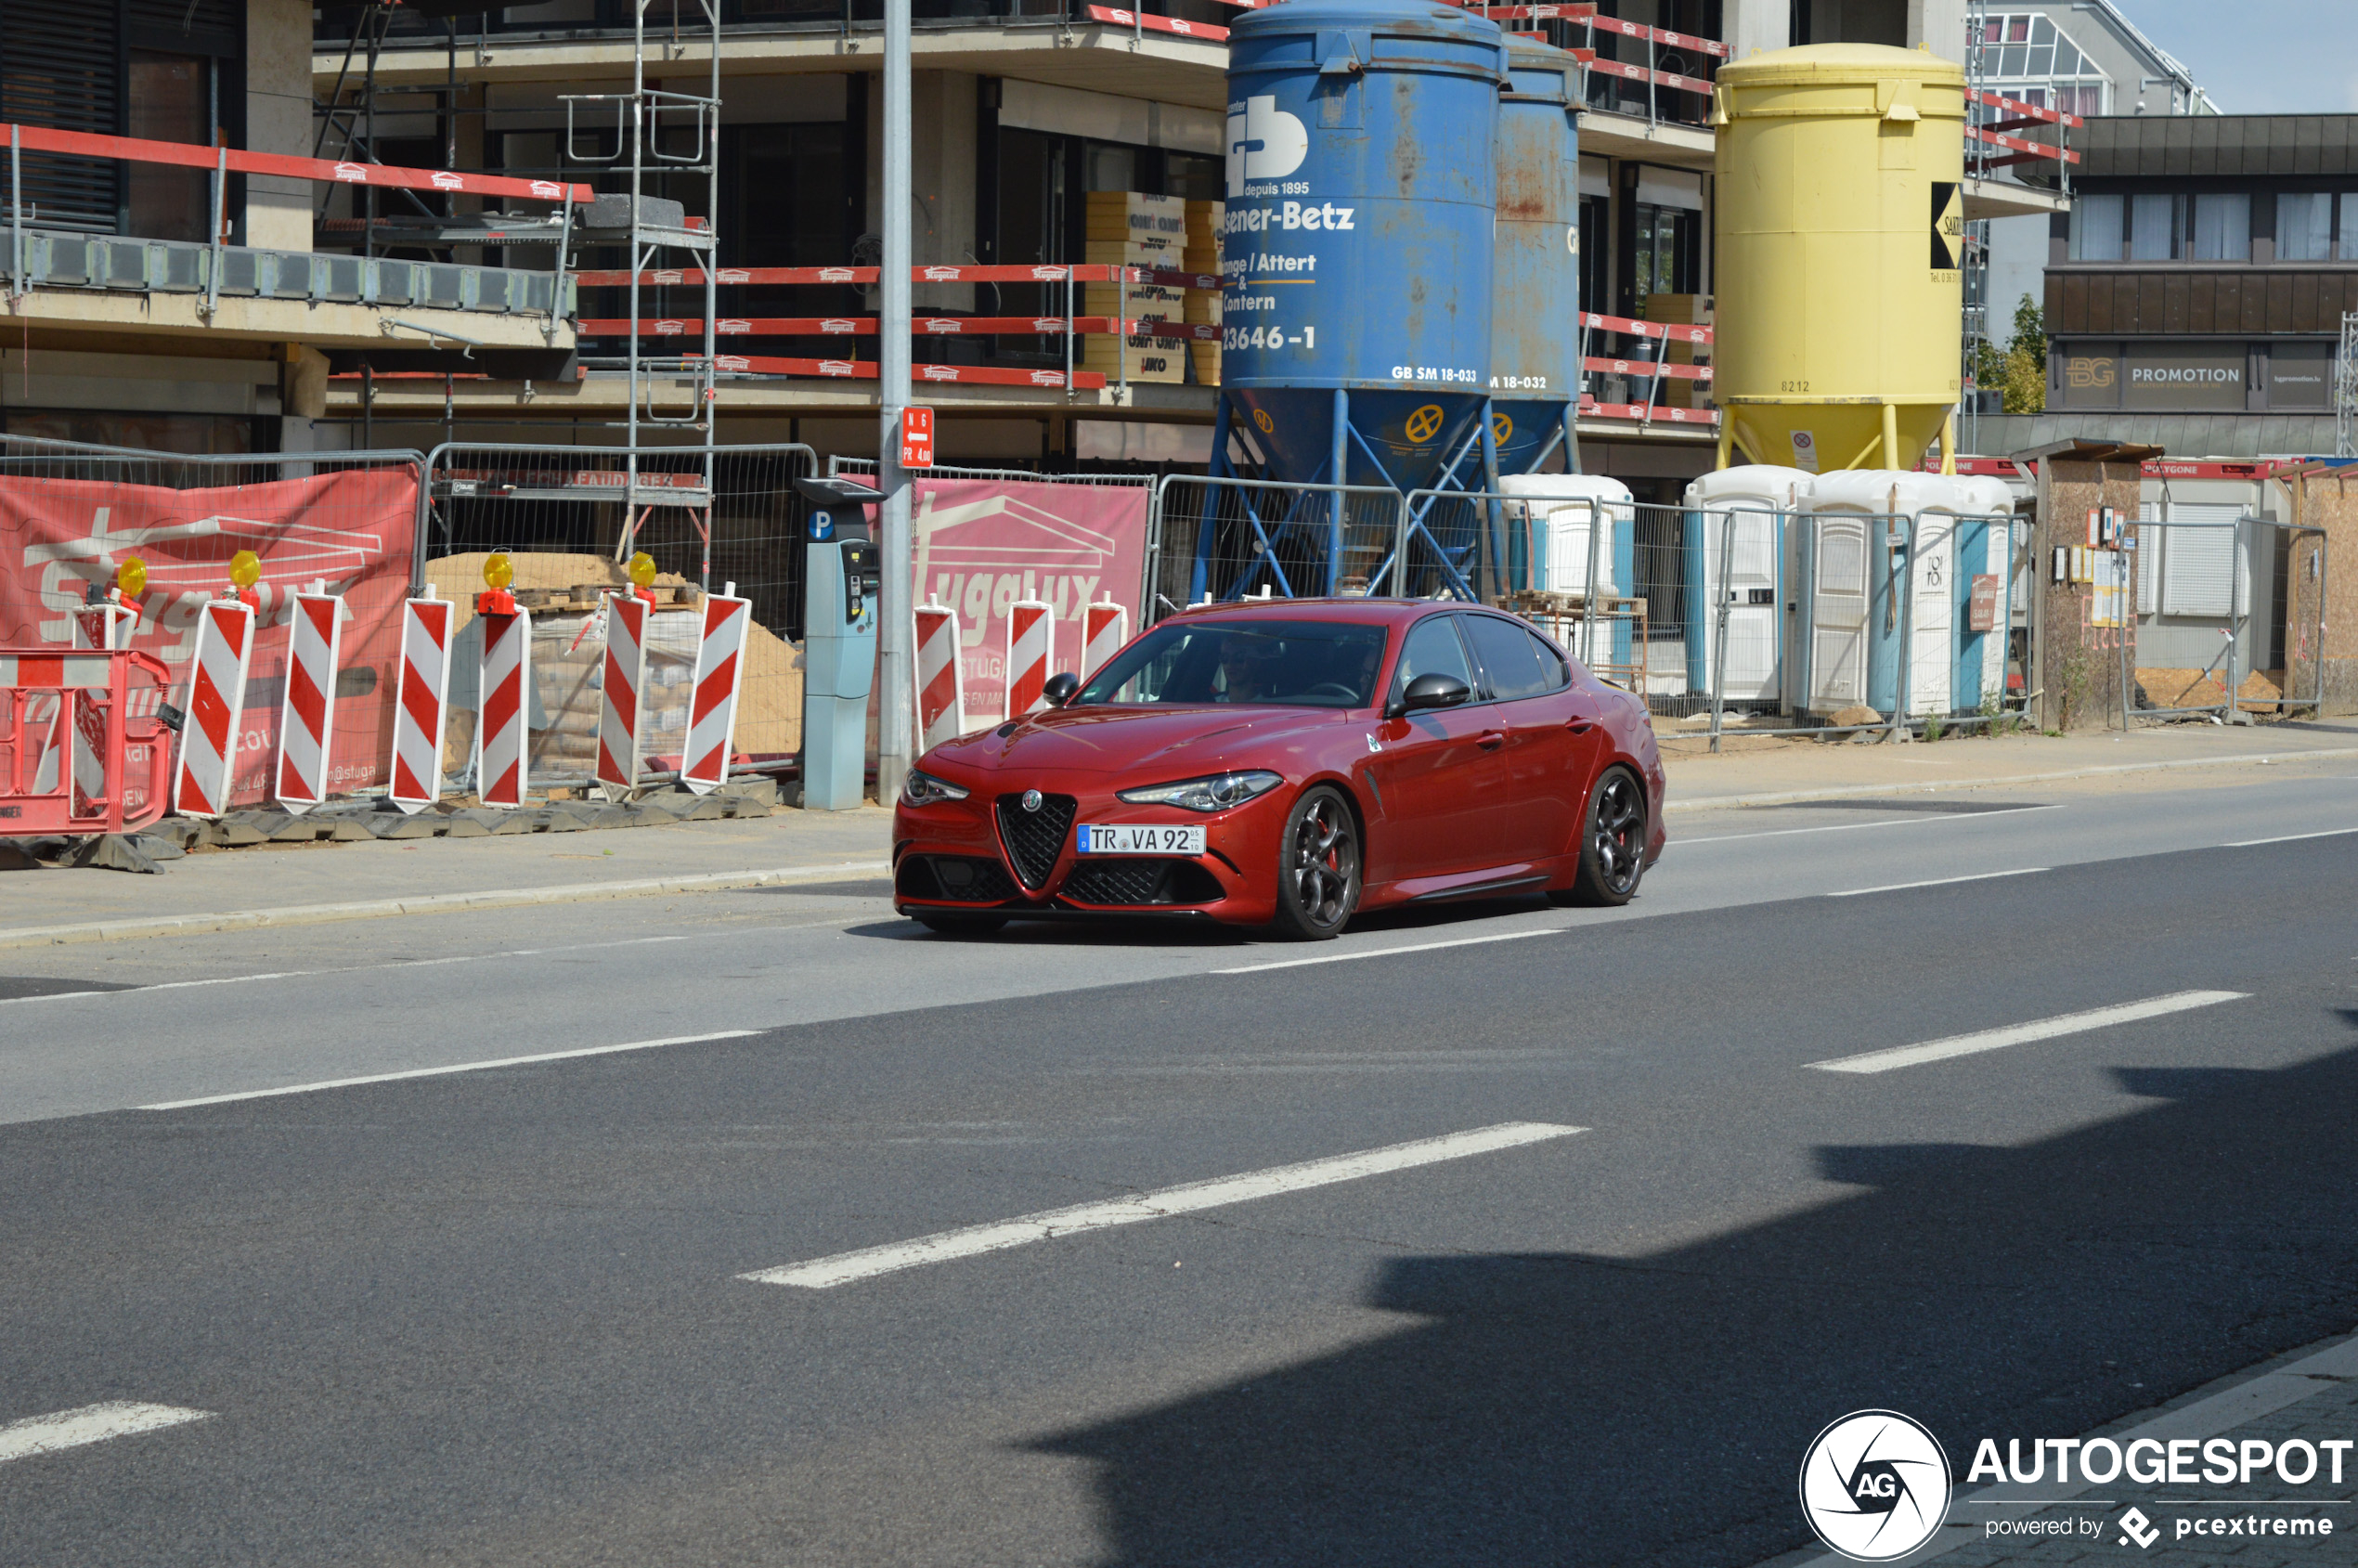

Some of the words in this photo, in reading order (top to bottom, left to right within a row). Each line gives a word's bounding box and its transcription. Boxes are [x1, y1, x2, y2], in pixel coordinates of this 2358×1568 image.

[1245, 183, 1278, 198] depuis
[1281, 182, 1309, 195] 1895
[1257, 253, 1316, 271] Attert
[925, 270, 959, 281] Stugalux
[1238, 275, 1247, 291] &
[1224, 293, 1276, 312] Contern
[926, 323, 961, 333] Stugalux
[1145, 357, 1167, 372] IKO
[2066, 356, 2115, 387] BG
[820, 365, 852, 376] Stugalux
[924, 371, 958, 382] Stugalux
[1032, 375, 1067, 386] Stugalux
[1392, 366, 1413, 380] GB
[1417, 367, 1438, 381] SM
[1441, 369, 1476, 382] 18-033
[2132, 369, 2239, 382] PROMOTION
[1503, 376, 1546, 389] 18-032
[1781, 381, 1809, 392] 8212
[909, 412, 913, 426] N
[921, 413, 926, 427] 6
[903, 447, 913, 460] PR
[917, 447, 931, 462] 4,00
[2144, 464, 2197, 474] POLYGONE
[816, 511, 831, 538] P
[971, 692, 986, 706] EN
[988, 693, 1004, 706] MA
[1092, 829, 1116, 849] TR
[1132, 829, 1158, 849] VA
[1164, 830, 1189, 850] 92
